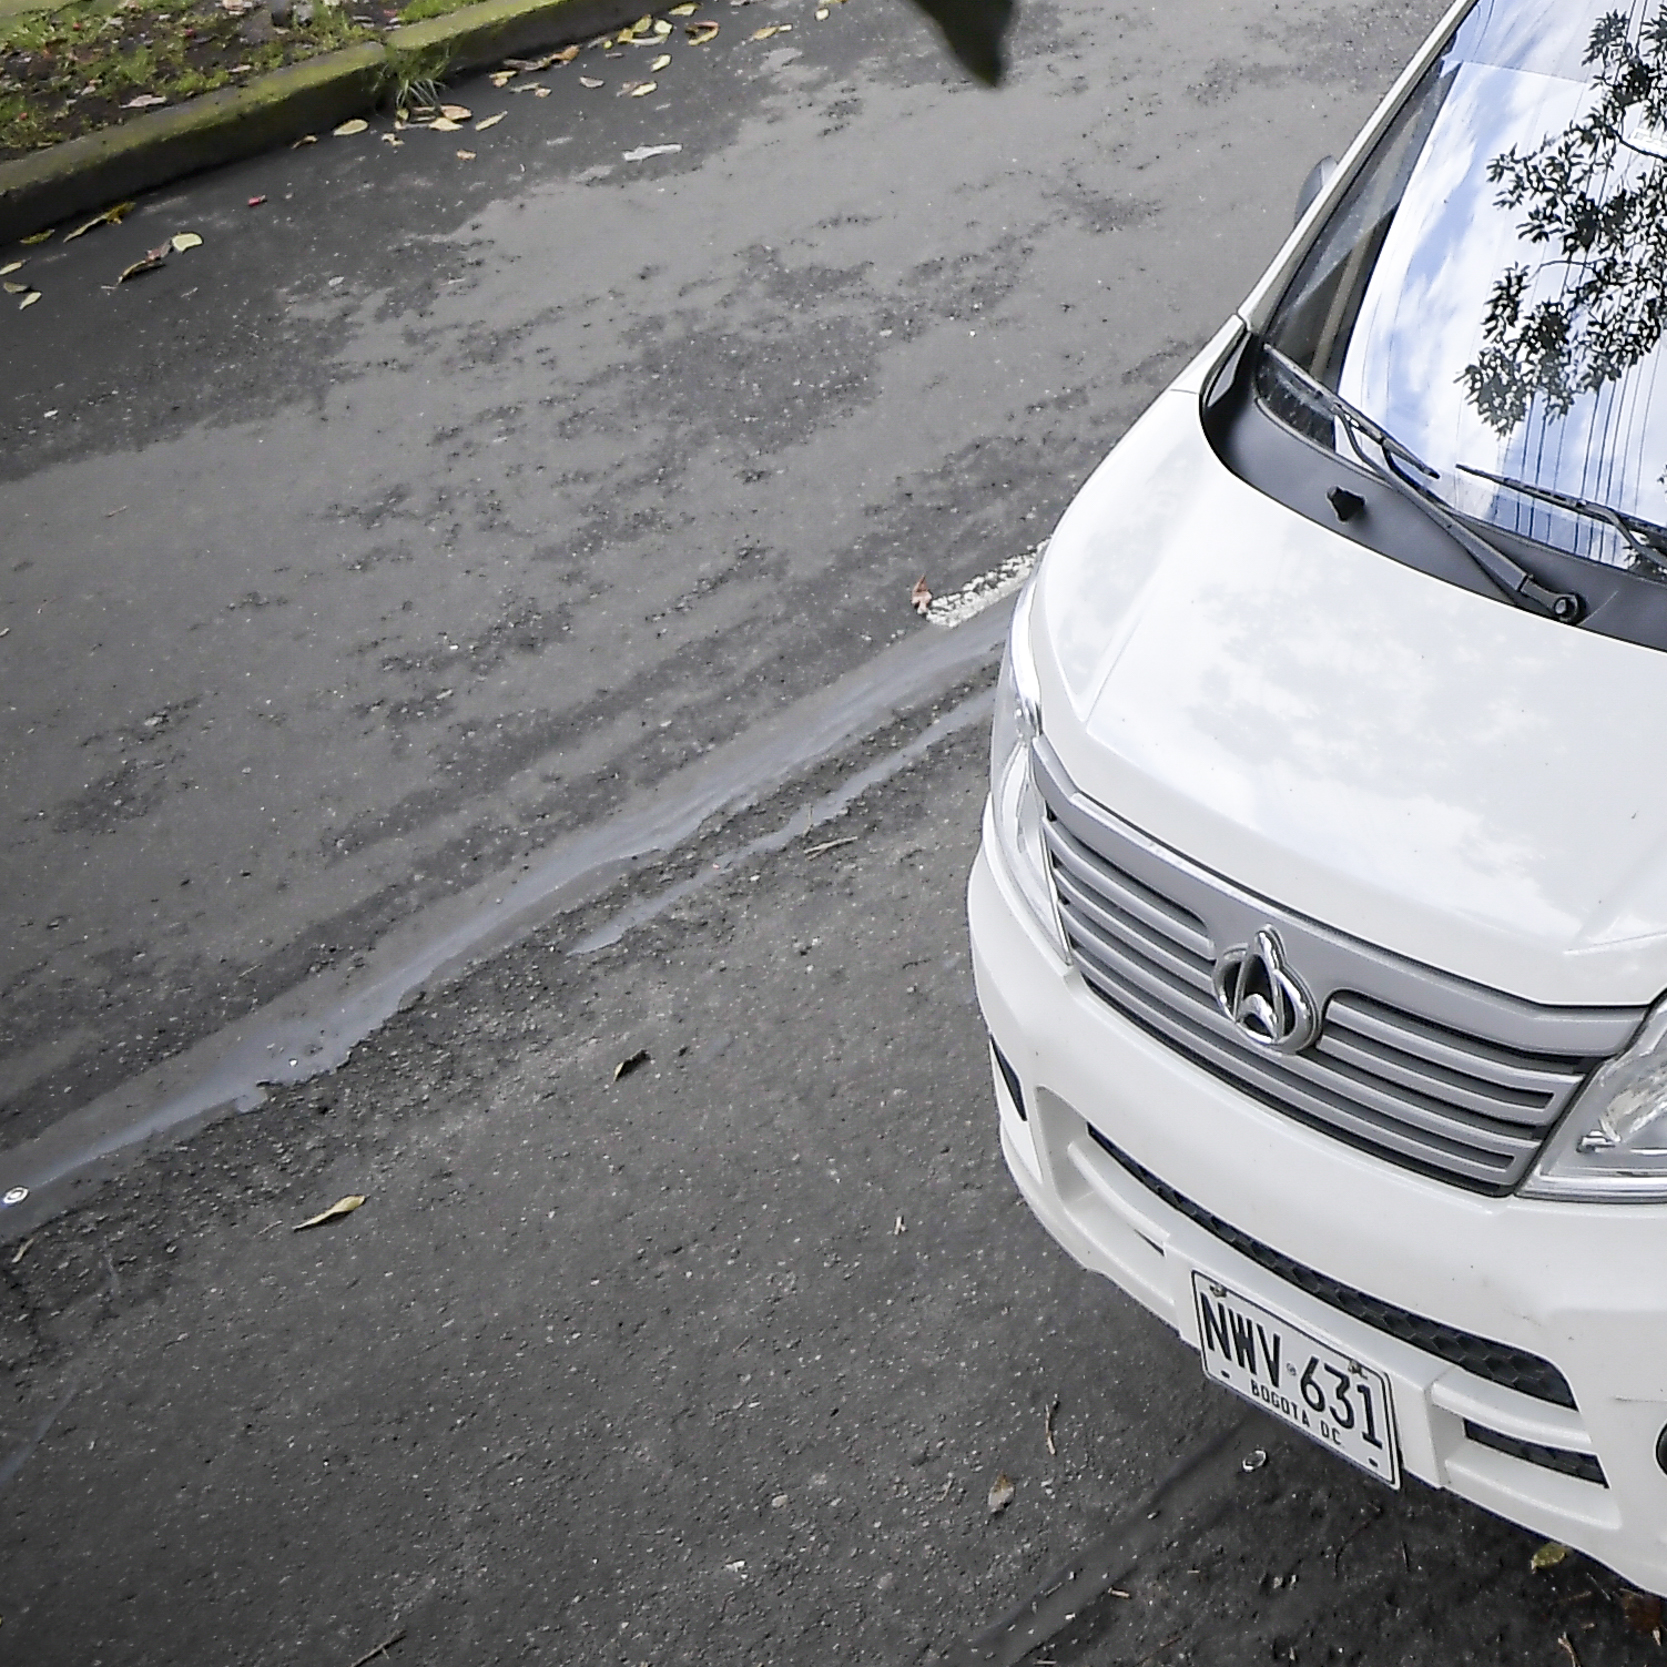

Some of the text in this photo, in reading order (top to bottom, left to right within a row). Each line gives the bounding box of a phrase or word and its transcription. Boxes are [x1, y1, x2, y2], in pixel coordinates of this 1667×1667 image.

[1200, 1291, 1383, 1450] NWV 631
[1251, 1378, 1343, 1446] BOGOTA DC
